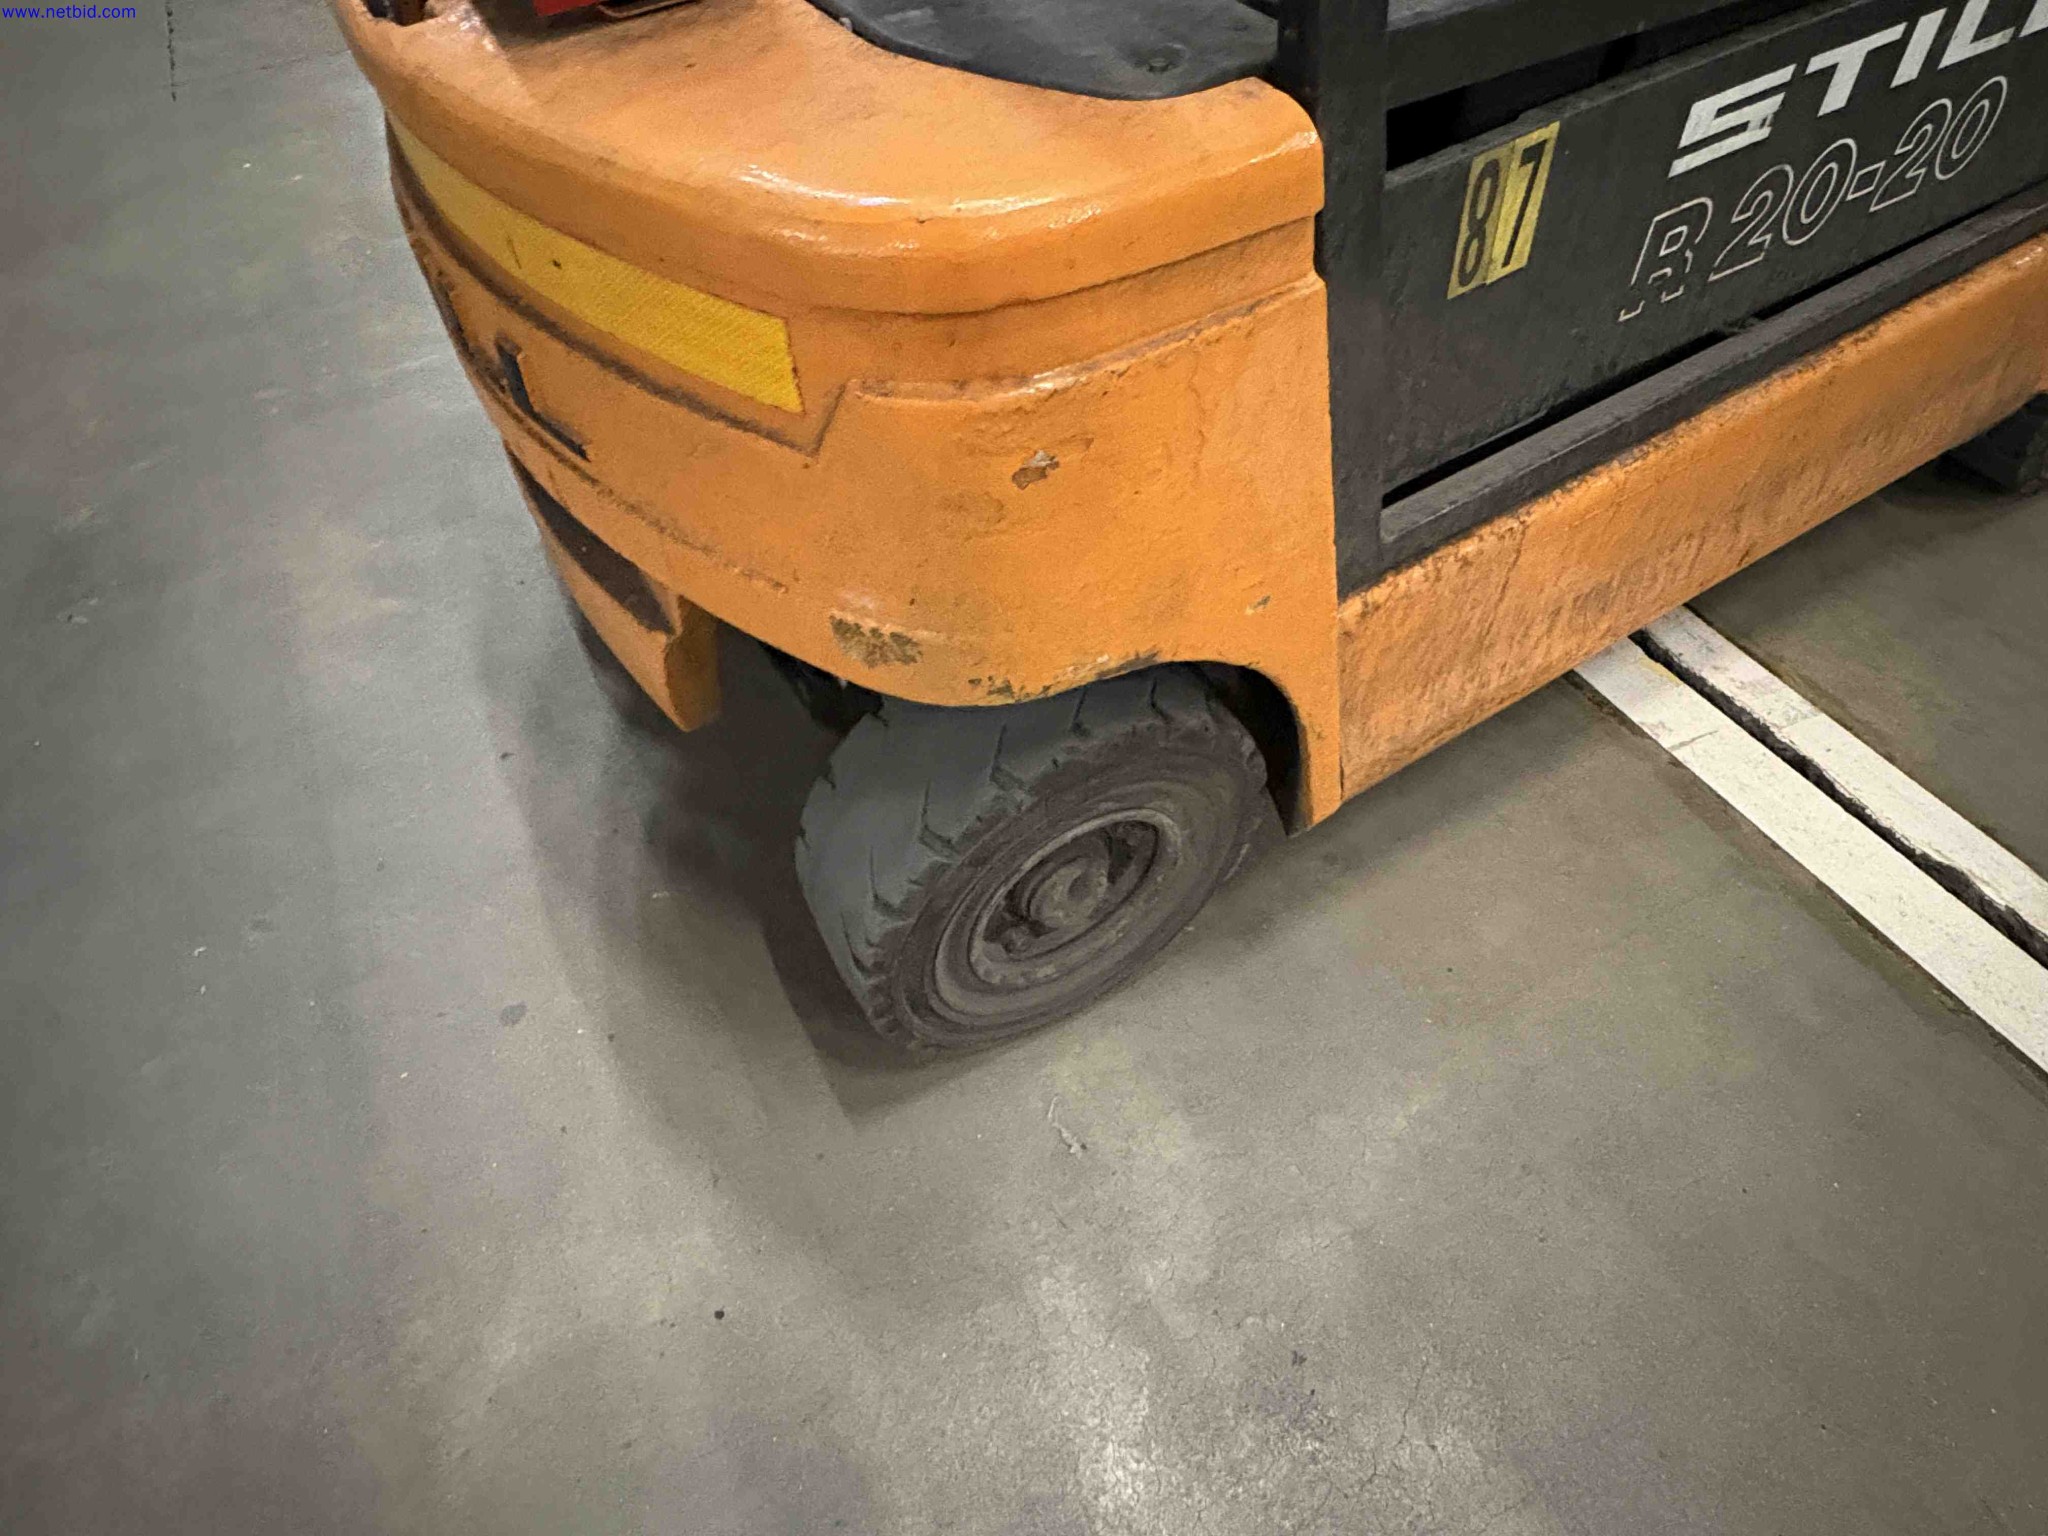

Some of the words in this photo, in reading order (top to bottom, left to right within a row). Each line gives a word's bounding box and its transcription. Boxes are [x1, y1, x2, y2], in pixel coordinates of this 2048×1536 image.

[1458, 139, 1548, 286] 87
[1618, 197, 1713, 322] R
[1708, 75, 2008, 282] 20-20
